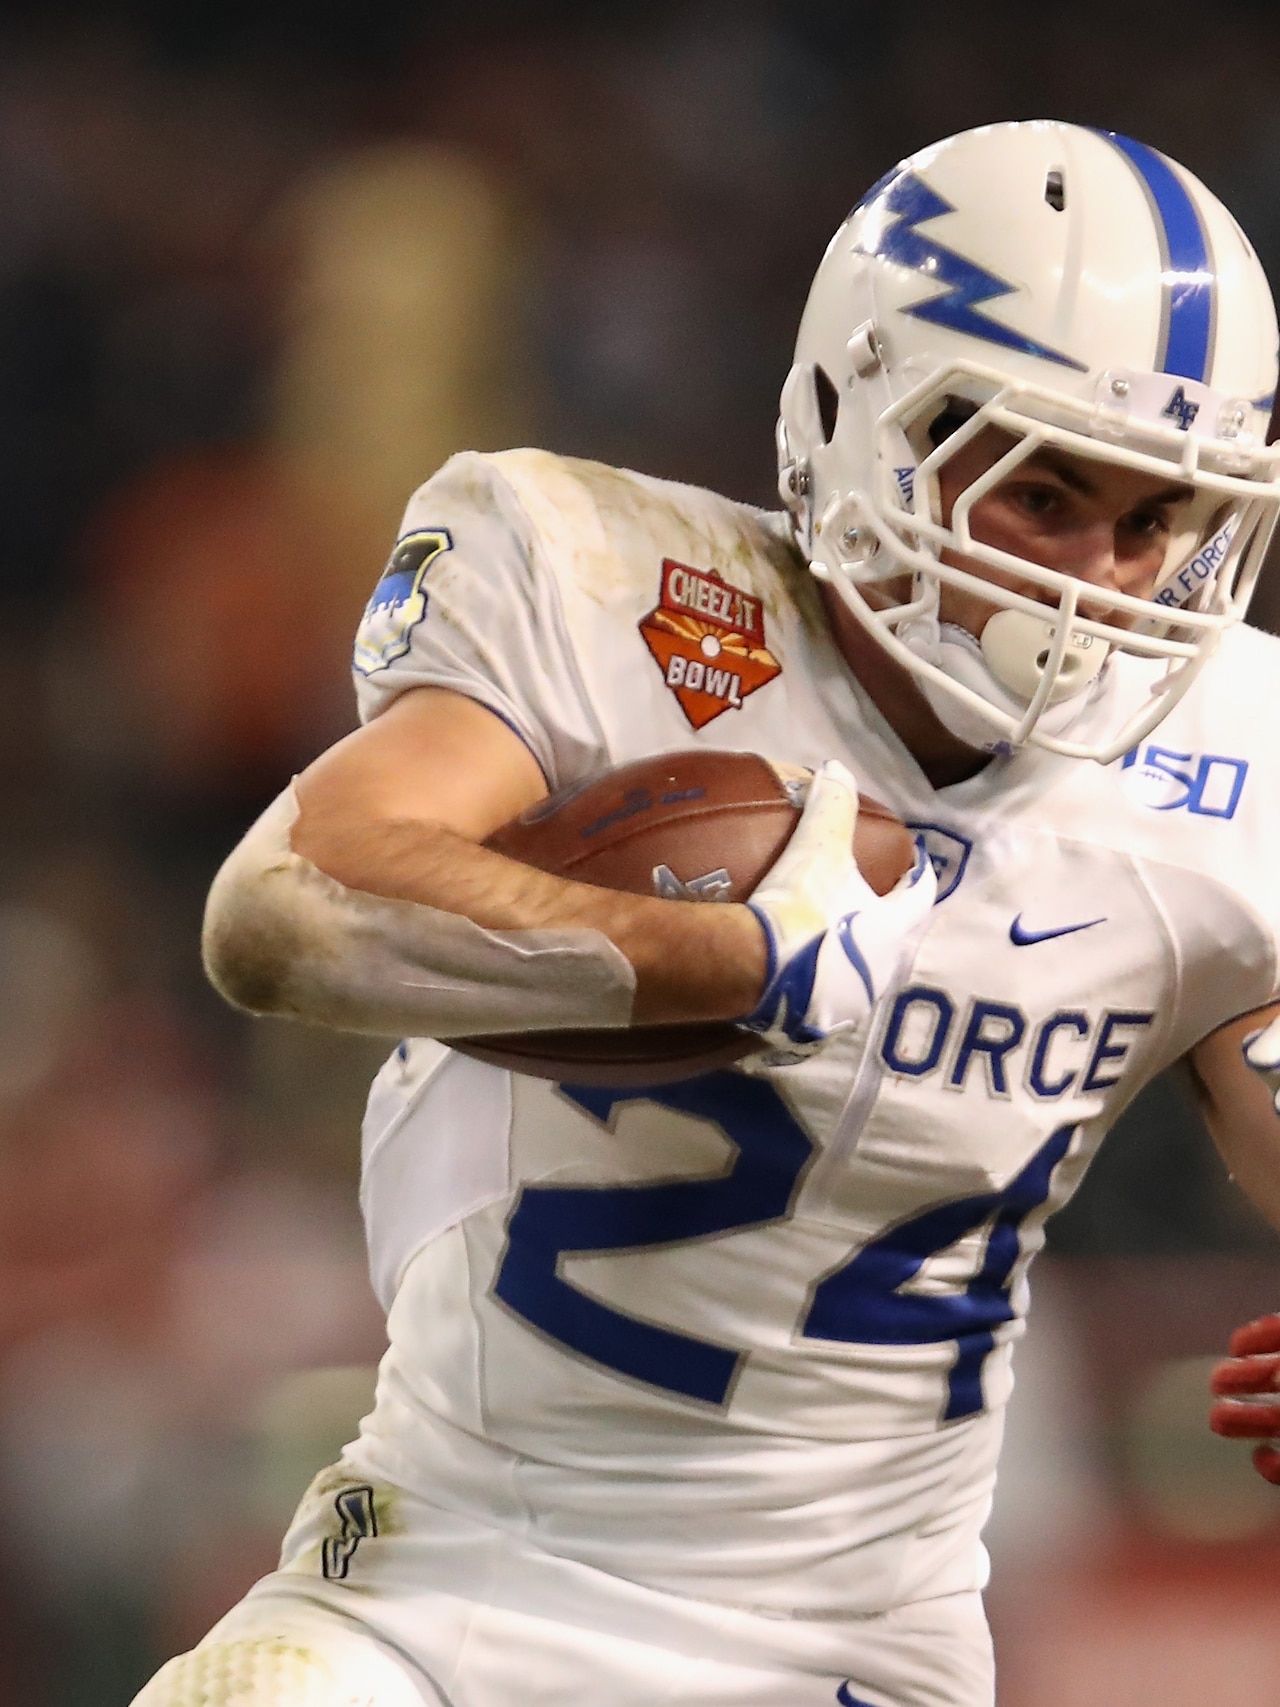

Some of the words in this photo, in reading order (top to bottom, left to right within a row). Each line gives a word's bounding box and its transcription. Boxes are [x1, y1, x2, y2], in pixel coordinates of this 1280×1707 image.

[666, 655, 742, 706] BOWL
[879, 982, 1156, 1101] ORCE
[488, 1074, 1082, 1428] 24
